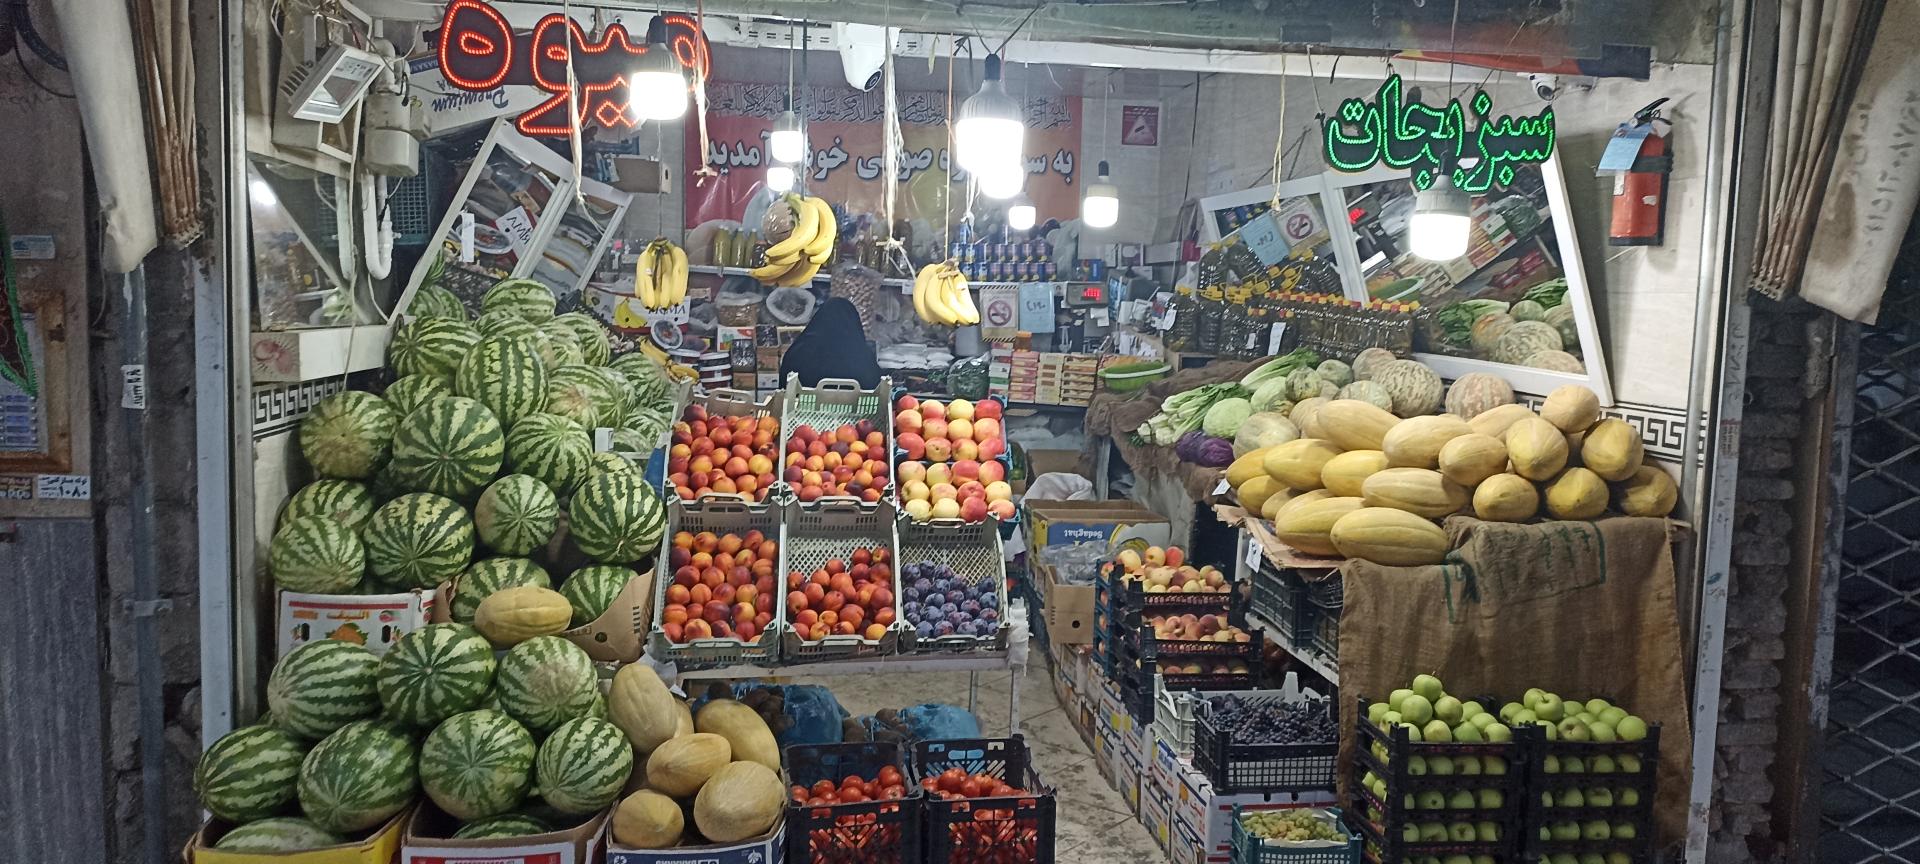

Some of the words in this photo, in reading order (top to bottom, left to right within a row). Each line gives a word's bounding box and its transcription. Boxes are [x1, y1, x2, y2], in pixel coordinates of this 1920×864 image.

[708, 130, 773, 176] آمدید
[1326, 74, 1554, 193] سبزیجات
[1052, 147, 1075, 185] به
